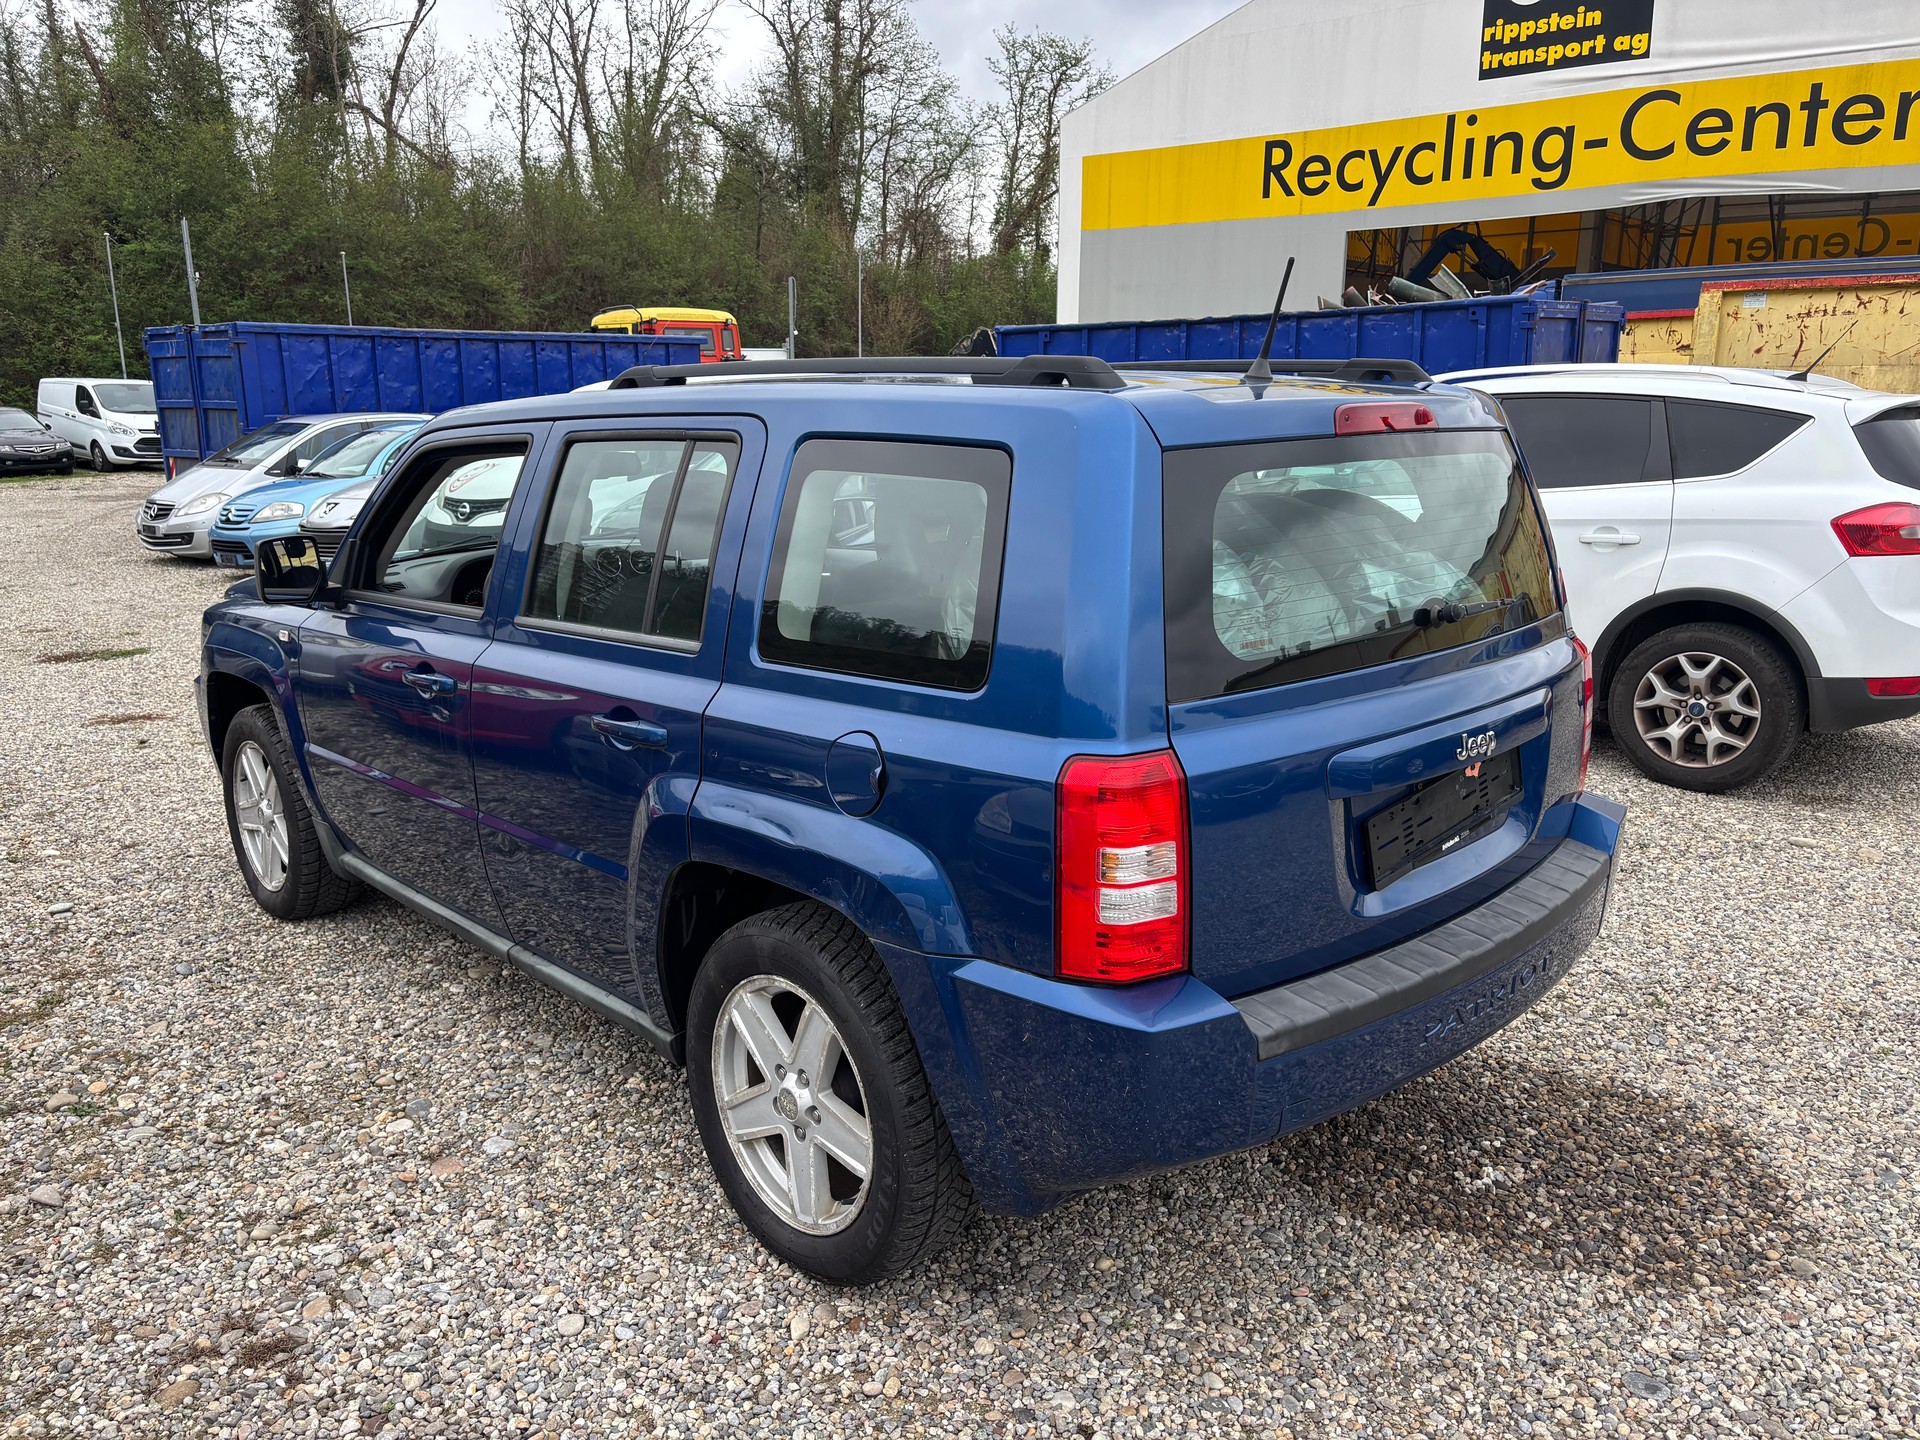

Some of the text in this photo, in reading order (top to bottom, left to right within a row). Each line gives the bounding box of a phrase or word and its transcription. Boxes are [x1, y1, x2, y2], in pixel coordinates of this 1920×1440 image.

[1484, 6, 1602, 44] rippstein
[1482, 33, 1649, 70] transport ag
[1261, 82, 1920, 207] Recycling-Center
[1456, 730, 1496, 760] Jeep
[1420, 950, 1552, 1047] PATRIOT
